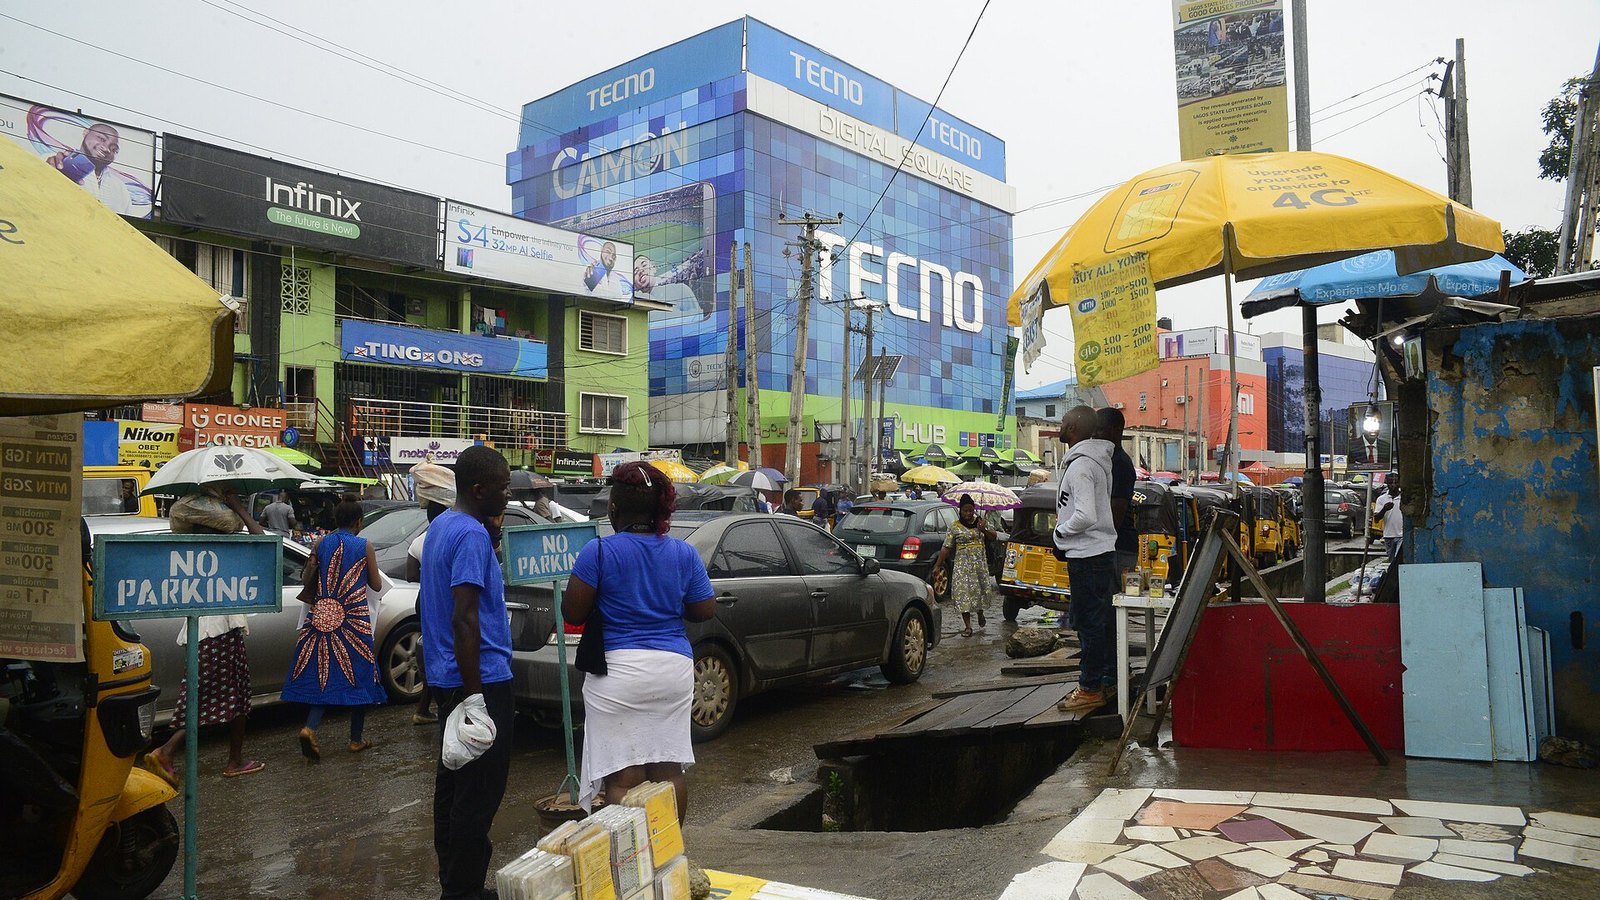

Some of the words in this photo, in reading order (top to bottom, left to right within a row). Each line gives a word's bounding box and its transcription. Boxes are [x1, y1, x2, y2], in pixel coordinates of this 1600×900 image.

[1188, 9, 1208, 18] GOOD
[789, 50, 863, 106] TECNO
[587, 67, 655, 112] TECNO
[1231, 96, 1257, 106] generated
[928, 116, 982, 160] TECNO
[551, 120, 689, 201] CAMON
[819, 108, 895, 162] DIGITAL
[901, 143, 973, 193] SQUARE
[1247, 165, 1323, 177] Upgrade
[1254, 176, 1292, 185] your
[1296, 172, 1329, 181] SIM
[1269, 181, 1328, 191] Device
[1331, 178, 1351, 186] to
[266, 177, 362, 222] Infinix
[1272, 188, 1359, 210] 4G
[449, 203, 476, 217] Infinix
[275, 210, 292, 223] The
[294, 215, 321, 229] future
[322, 220, 329, 231] is
[331, 223, 353, 236] Now!
[457, 218, 489, 247] S4
[491, 226, 529, 242] Empower
[531, 248, 553, 261] Selfie
[1072, 270, 1093, 285] BUY
[1096, 263, 1114, 278] ALL
[1117, 250, 1148, 268] YOUR
[804, 228, 984, 334] TECNO
[1316, 282, 1376, 300] Experience
[1378, 280, 1408, 293] More
[1130, 287, 1149, 301] 1500
[1080, 299, 1095, 311] MTN
[1103, 333, 1121, 346] 100
[1132, 322, 1151, 337] 200
[365, 341, 422, 361] TING
[1081, 344, 1099, 358] glo
[1104, 344, 1122, 357] 500
[1133, 334, 1152, 349] 1000
[215, 413, 282, 428] GIONEE
[123, 427, 175, 442] Nikon
[213, 432, 281, 448] CRYSTAL
[902, 422, 946, 444] HUB
[556, 458, 580, 466] Infinix
[1132, 490, 1148, 504] ER
[542, 533, 569, 554] NO
[170, 550, 218, 577] NO
[517, 551, 580, 576] PARKIN
[117, 575, 259, 606] PARKING
